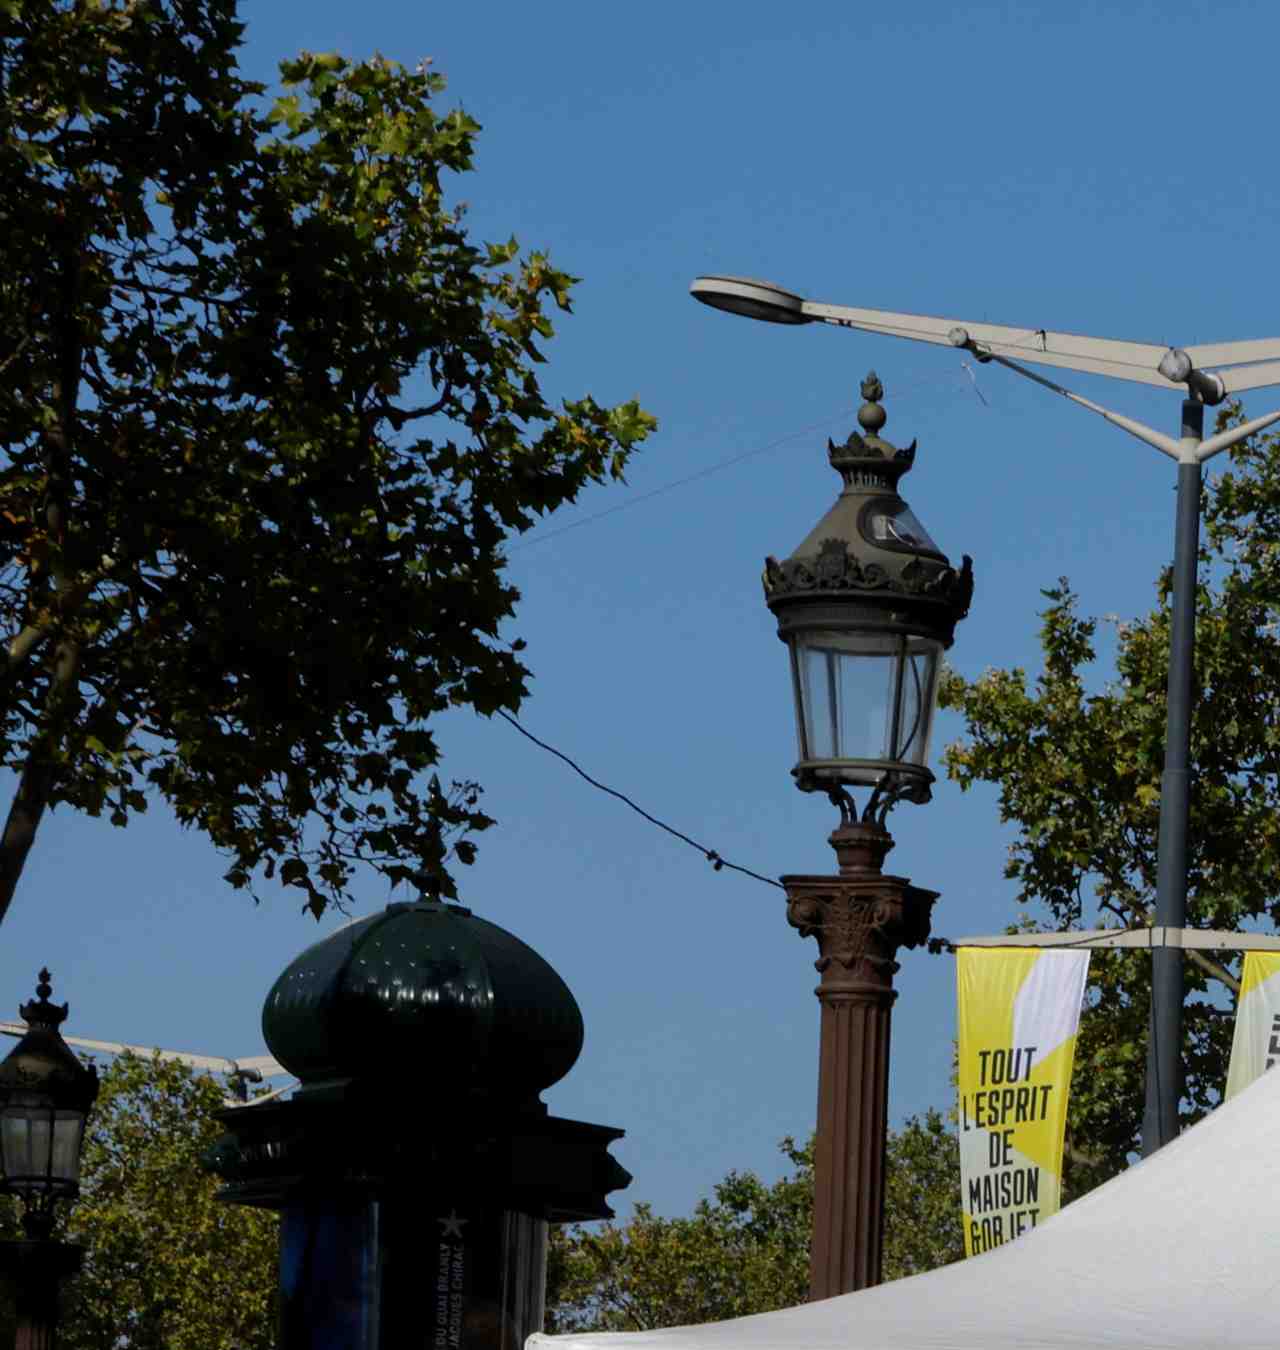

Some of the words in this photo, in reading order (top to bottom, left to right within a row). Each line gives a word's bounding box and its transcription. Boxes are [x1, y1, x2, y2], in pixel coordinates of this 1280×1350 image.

[978, 1047, 1037, 1087] TOUT
[963, 1083, 1054, 1131] L'ESPRIT
[989, 1129, 1015, 1168] DE
[968, 1166, 1040, 1217] MAISON
